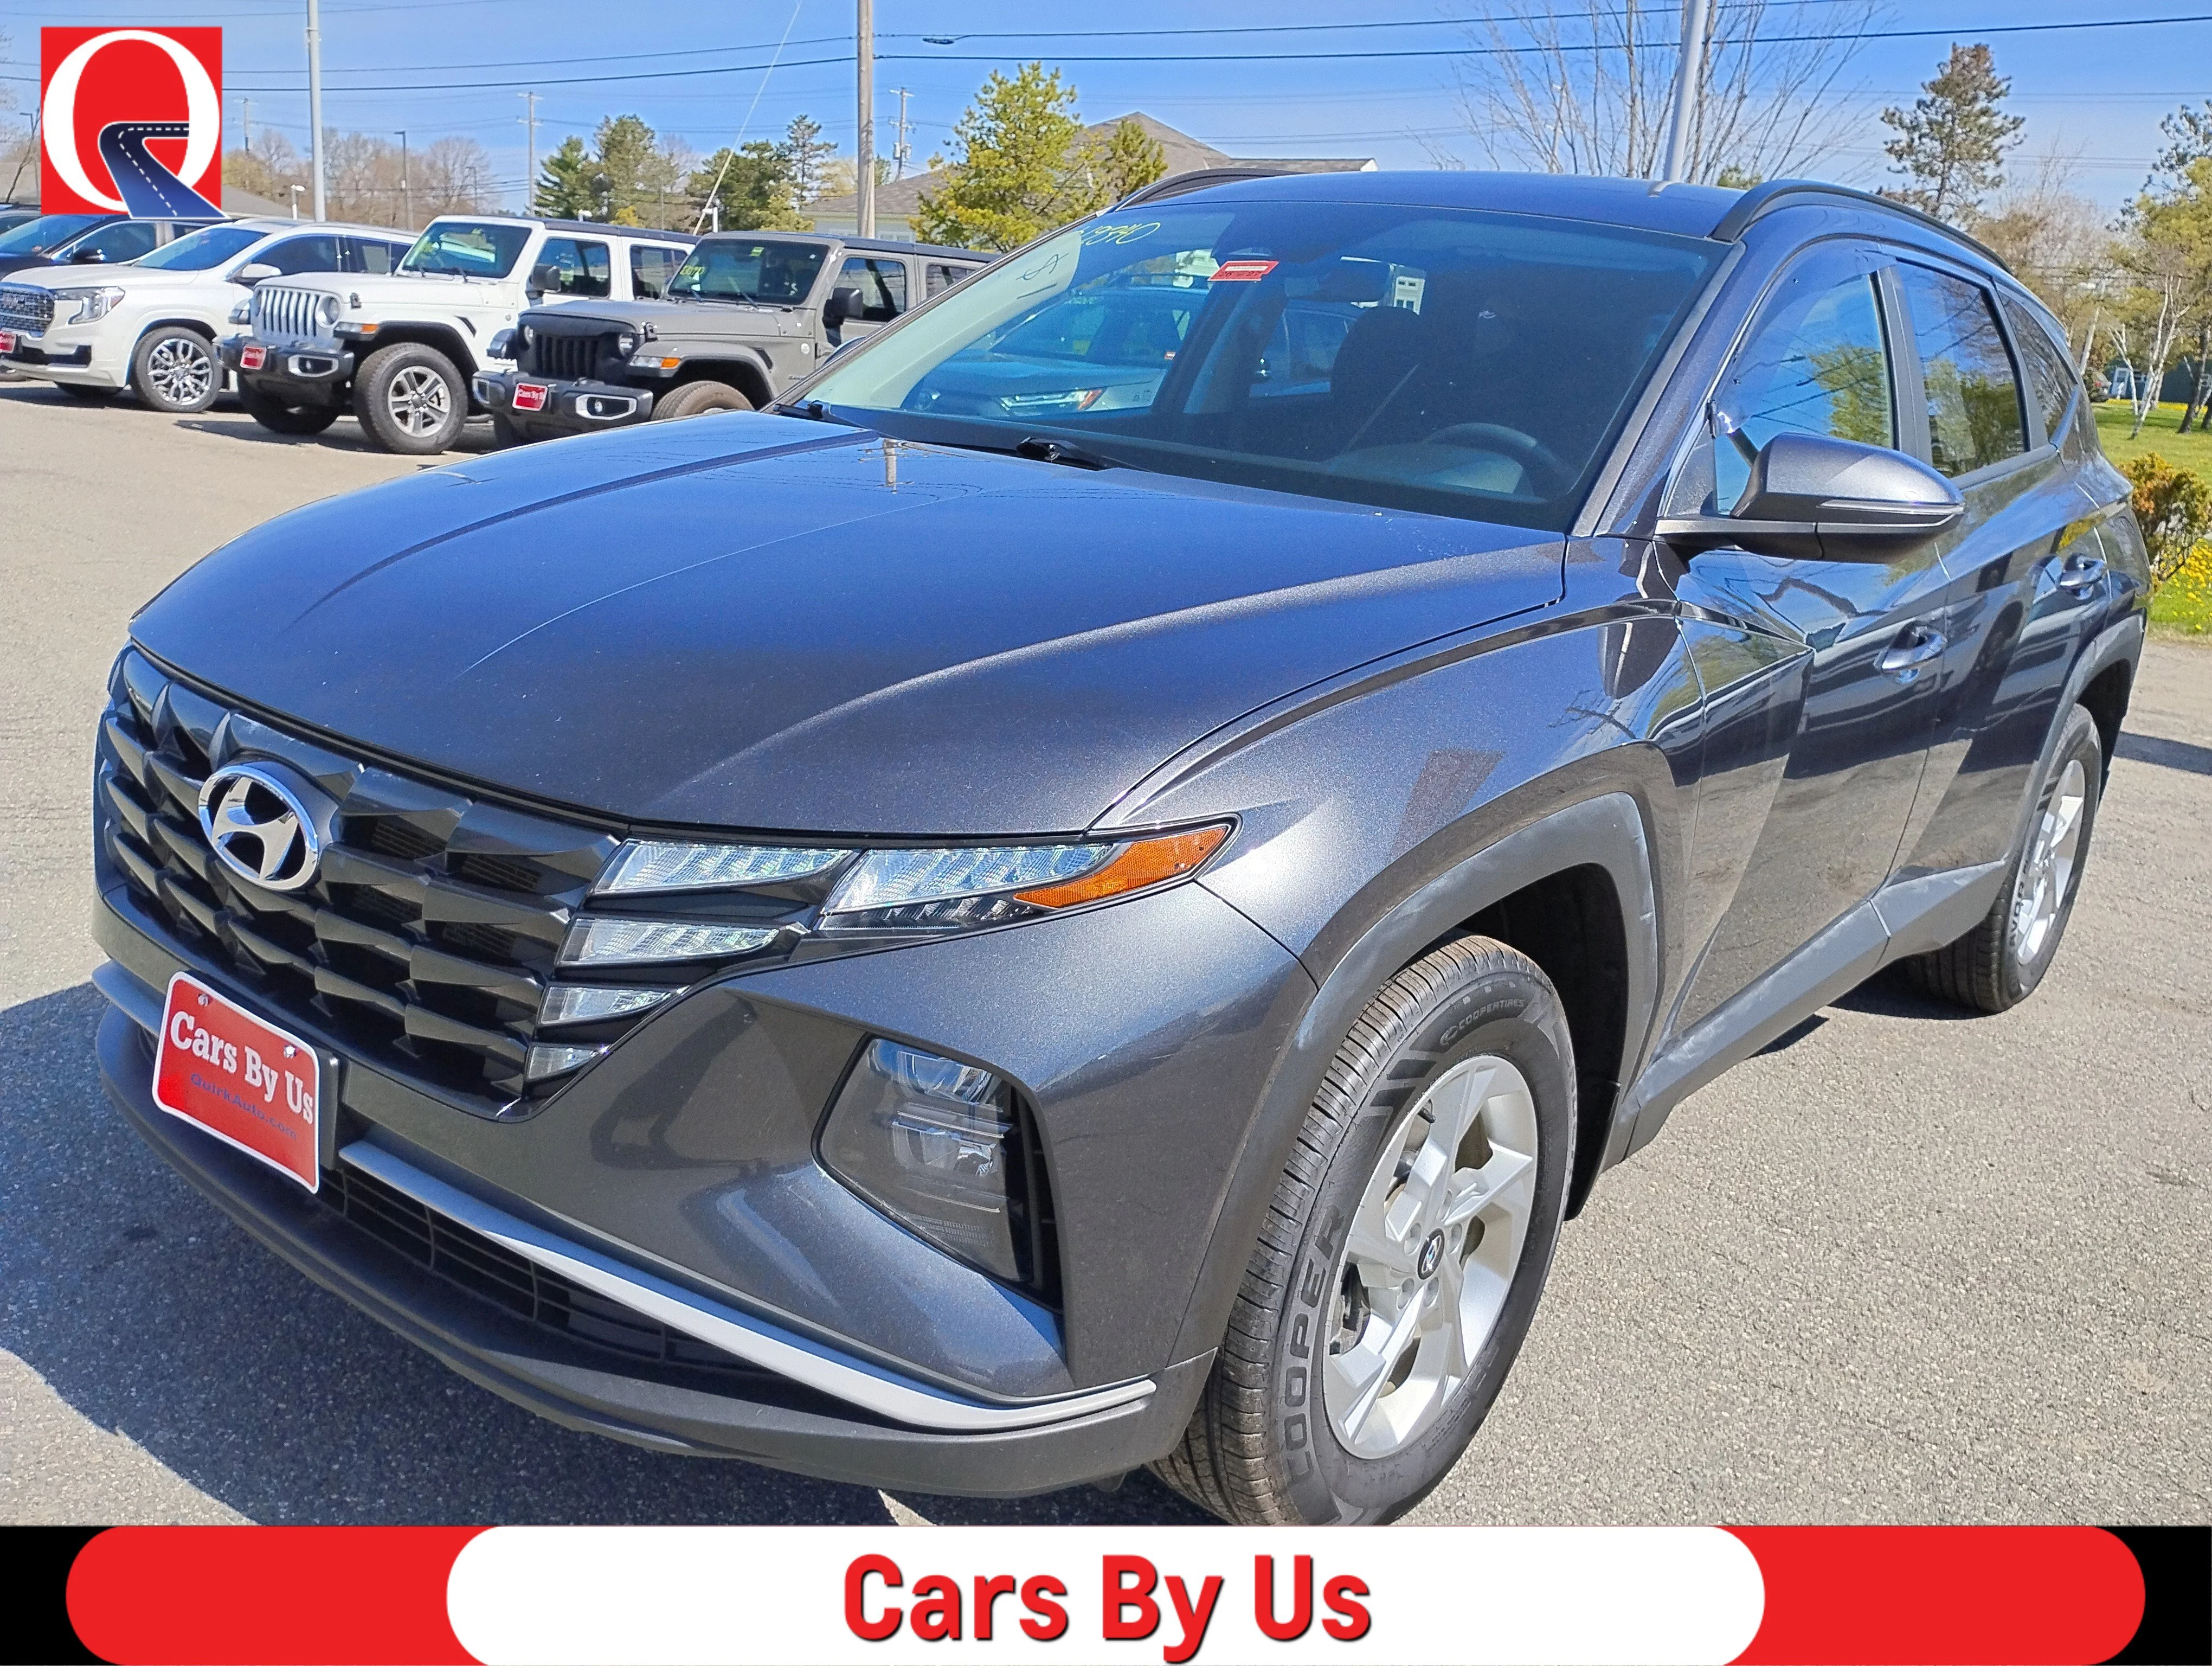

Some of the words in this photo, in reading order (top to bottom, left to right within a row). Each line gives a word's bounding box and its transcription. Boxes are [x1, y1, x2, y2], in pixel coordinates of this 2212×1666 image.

[171, 1011, 237, 1074] Cars
[245, 1045, 279, 1103] By
[285, 1070, 313, 1125] Us
[190, 1073, 297, 1140] QuirkAuto.com
[1284, 1203, 1345, 1482] COOPER
